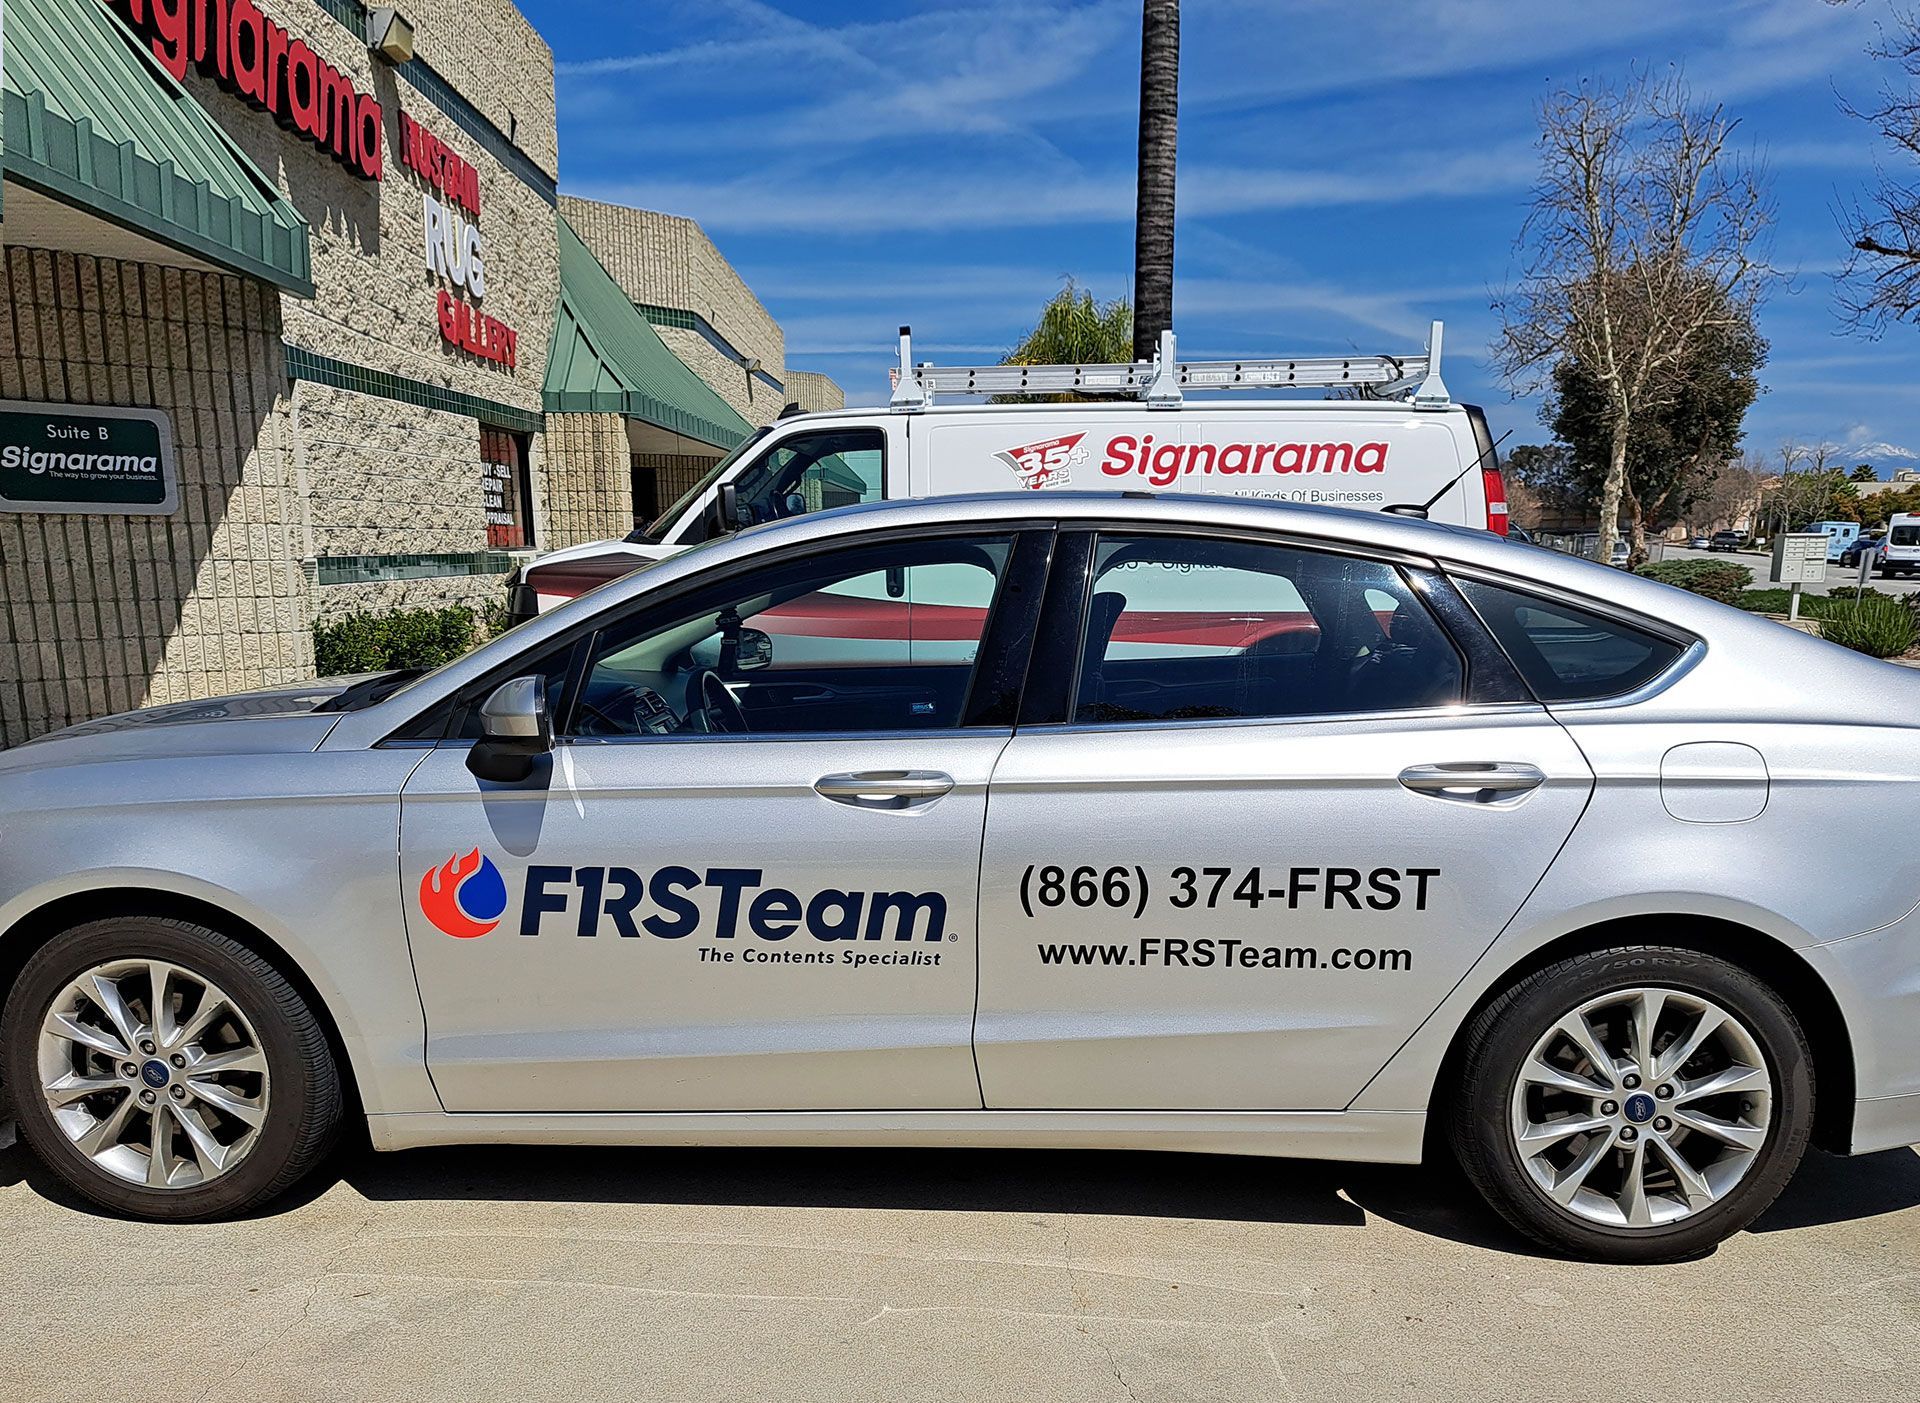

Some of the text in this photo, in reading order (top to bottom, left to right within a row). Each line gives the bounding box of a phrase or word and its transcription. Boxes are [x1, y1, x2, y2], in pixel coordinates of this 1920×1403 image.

[129, 0, 382, 182] gnarama
[424, 194, 484, 299] RUG
[437, 289, 517, 369] GALLERY
[46, 424, 109, 440] Suite B
[1, 445, 157, 475] Signarama
[1101, 435, 1388, 486] Signarama
[49, 471, 63, 479] The
[64, 472, 79, 480] way
[1018, 468, 1070, 488] YEARS
[484, 494, 502, 508] LEAN
[1291, 490, 1307, 502] Of
[1311, 490, 1383, 502] Businesses
[486, 511, 514, 525] PPRAISAL
[1019, 864, 1441, 918] (866) 374-FRST
[699, 948, 941, 968] The Contents Specialist
[1037, 938, 1412, 971] www.FRSTeam.com
